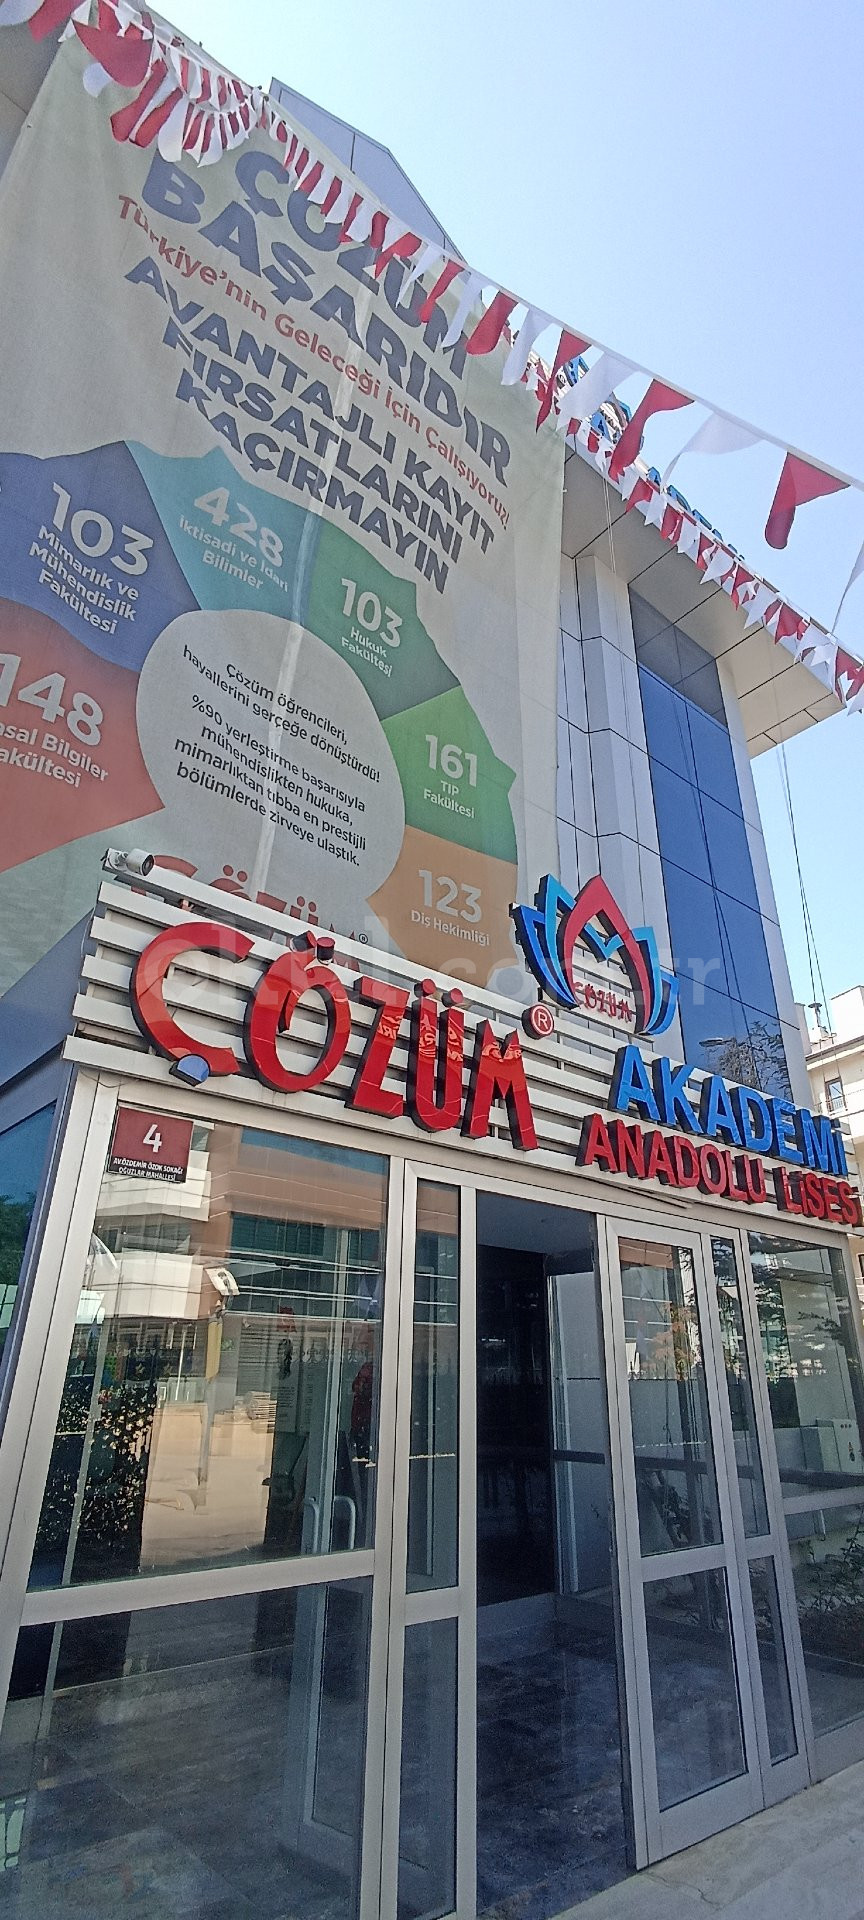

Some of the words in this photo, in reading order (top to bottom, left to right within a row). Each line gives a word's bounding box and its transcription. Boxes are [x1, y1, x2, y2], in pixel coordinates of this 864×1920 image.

[142, 149, 510, 488] BAŞARIDIR
[124, 256, 397, 464] AVANTAJLI
[403, 448, 495, 554] KAYIT
[163, 316, 463, 564] FIRSATLARINI
[274, 313, 381, 399] Geleceği
[425, 426, 510, 530] Çalışıyoruz!
[175, 367, 449, 594] KAÇIRMAYIN
[38, 525, 114, 590] Mimarlık
[117, 582, 139, 600] ve
[52, 482, 154, 576] 103
[194, 487, 284, 567] 428
[240, 550, 257, 567] ve
[29, 542, 137, 621] Mühendislik
[38, 568, 118, 634] Fakültesi
[202, 549, 264, 589] Bilimler
[341, 578, 403, 647] 103
[350, 627, 387, 657] Hukuk
[341, 636, 393, 678] Fakültesi
[0, 653, 104, 746] 148
[183, 644, 250, 707] hayallerini
[252, 702, 308, 740] gerçeğe
[310, 733, 381, 783] dönüştürdü!
[226, 663, 274, 702] Çözüm
[277, 693, 348, 744] öğrencileri,
[42, 733, 108, 781] Bilgiler
[192, 694, 222, 726] %90
[225, 721, 299, 775] yerleştirme
[302, 767, 366, 812] başarısıyla
[201, 724, 304, 798] mühendislikten
[306, 788, 353, 826] hukuka,
[425, 734, 478, 787] 161
[440, 780, 459, 796] TIP
[174, 738, 264, 796] mimarlıktan
[267, 788, 300, 816] tıbba
[303, 810, 319, 826] en
[322, 818, 366, 851] prestijli
[176, 761, 267, 816] bölümlerde
[269, 810, 315, 843] zirveye
[317, 835, 361, 866] ulaştık.
[423, 788, 475, 819] Fakültesi
[411, 909, 431, 927] Diş
[433, 916, 490, 947] Hekimliği
[418, 869, 483, 923] 123
[130, 921, 540, 1151] ÇÖZÜM
[143, 1124, 162, 1153] 4
[608, 1044, 848, 1177] AKADEMİ
[575, 1113, 766, 1205] ANADOLU
